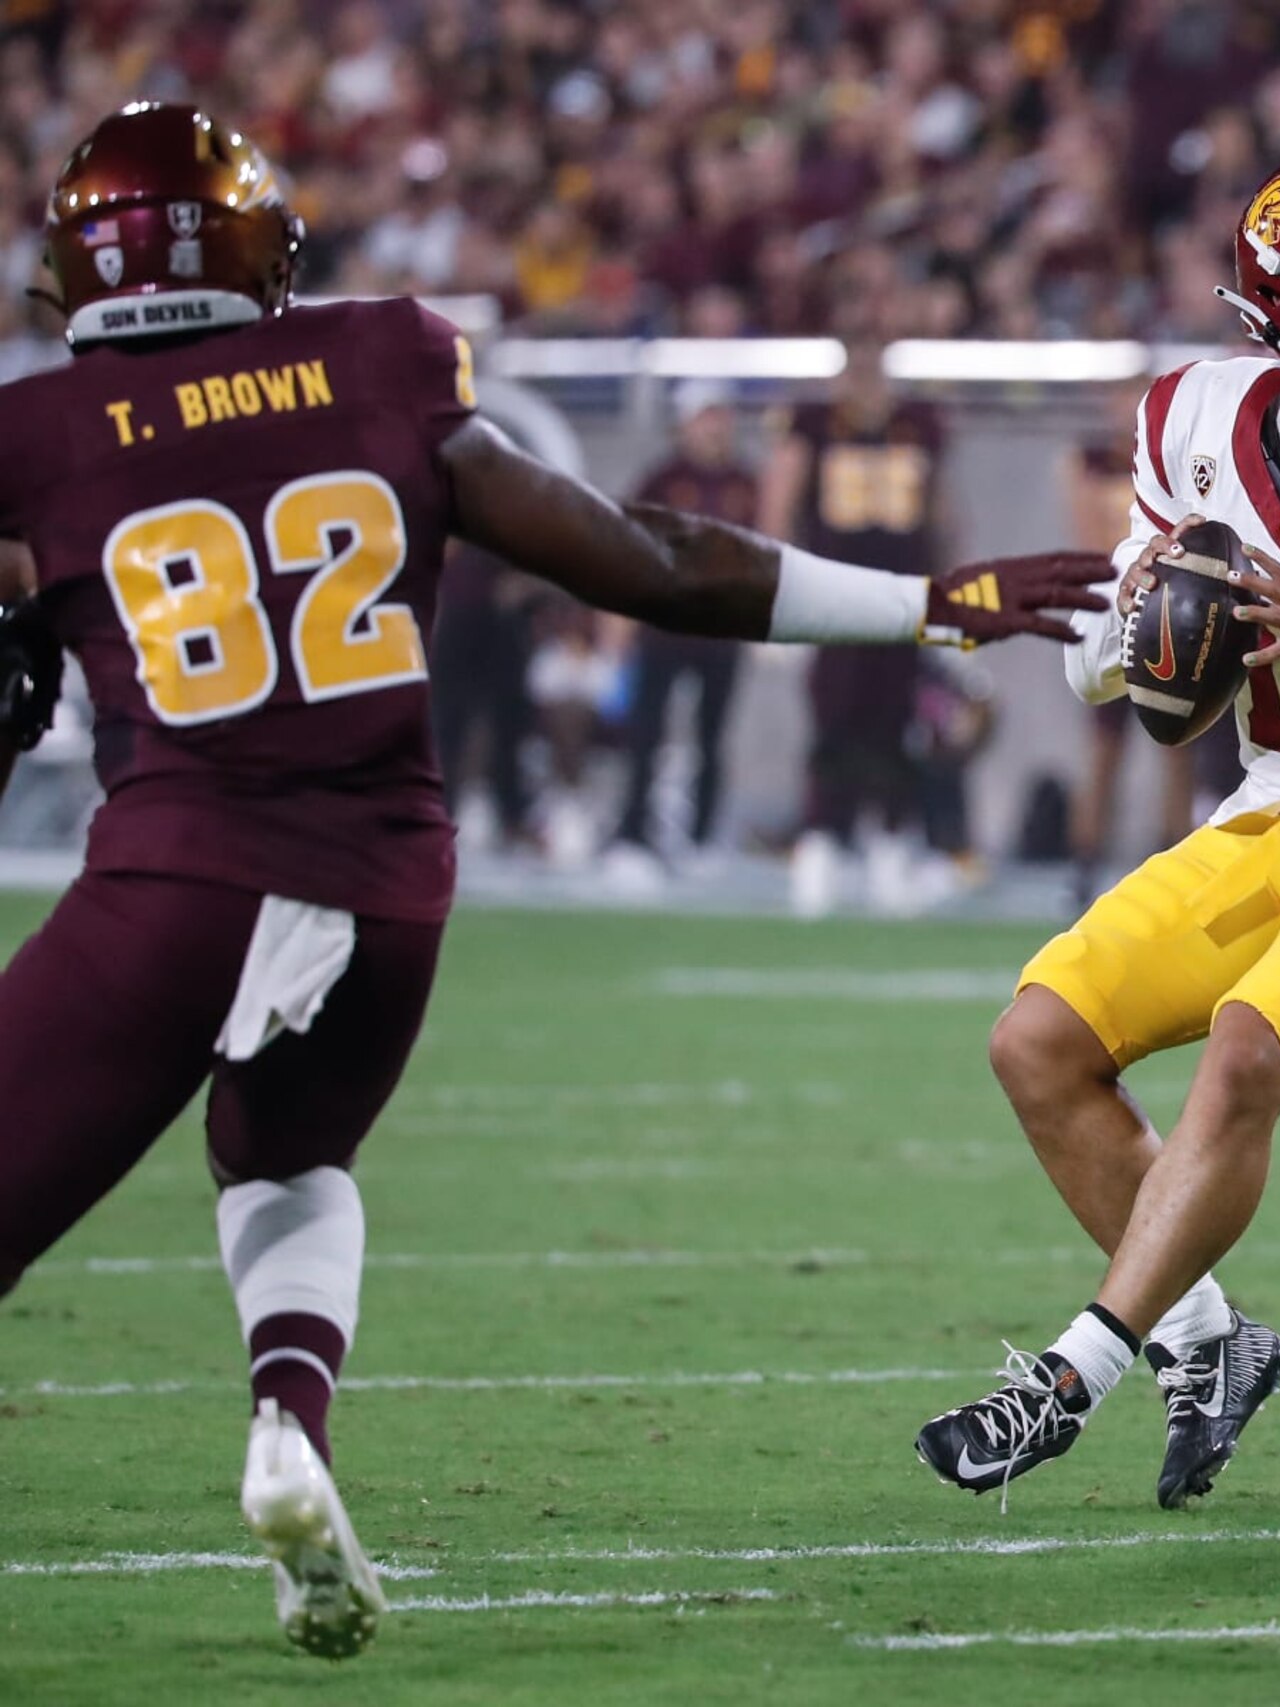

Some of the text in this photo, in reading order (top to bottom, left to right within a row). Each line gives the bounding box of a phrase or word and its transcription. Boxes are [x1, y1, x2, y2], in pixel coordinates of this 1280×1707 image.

[102, 301, 212, 331] SUN DEVILS
[105, 359, 334, 447] T. BROWN
[102, 470, 429, 728] 82
